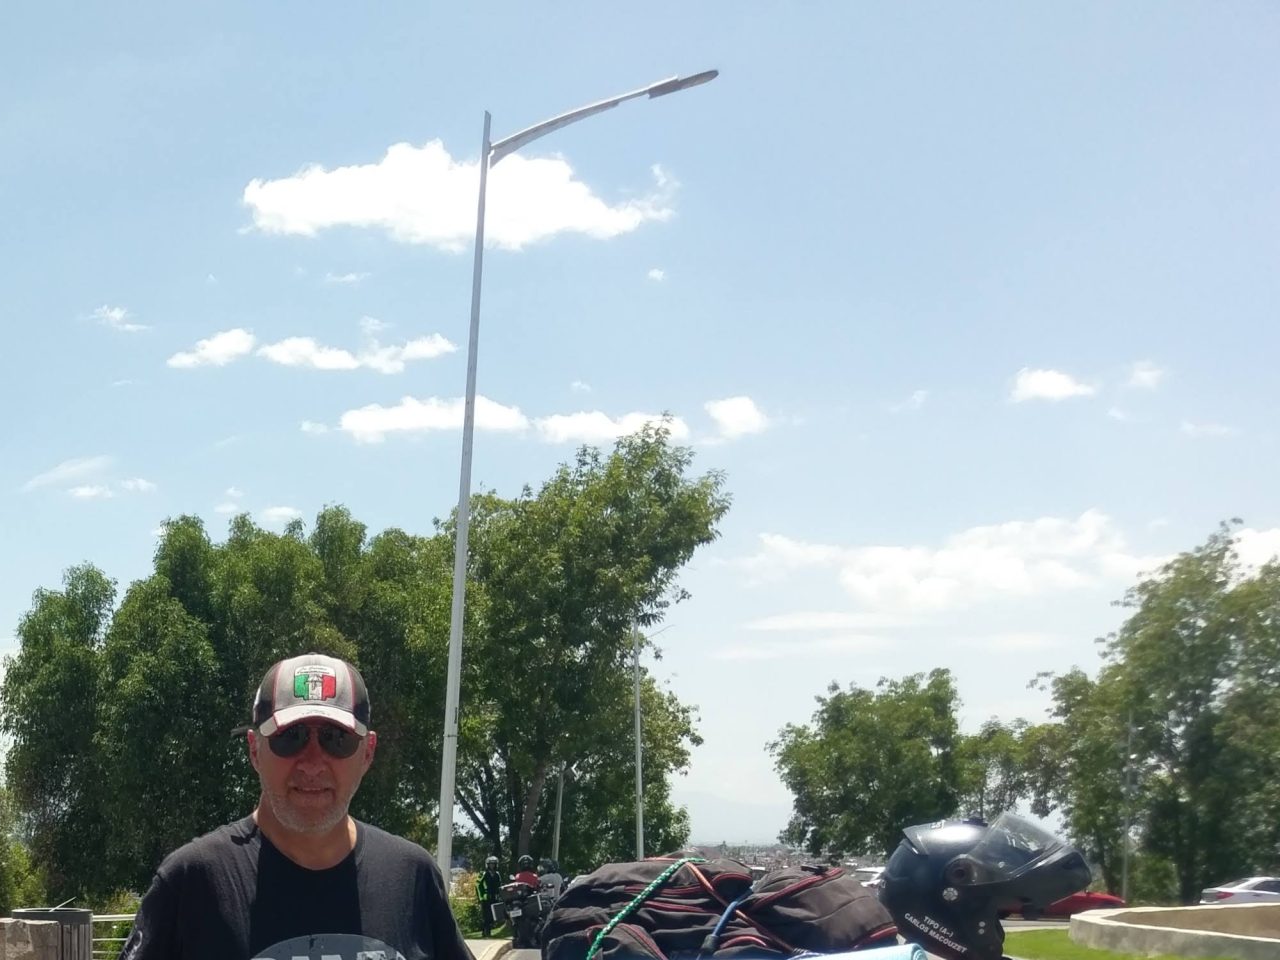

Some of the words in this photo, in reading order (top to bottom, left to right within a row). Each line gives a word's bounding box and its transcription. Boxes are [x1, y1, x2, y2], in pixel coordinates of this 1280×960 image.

[904, 912, 930, 933] CARLOS
[928, 929, 968, 954] MACOUZET
[924, 915, 940, 930] TIPO
